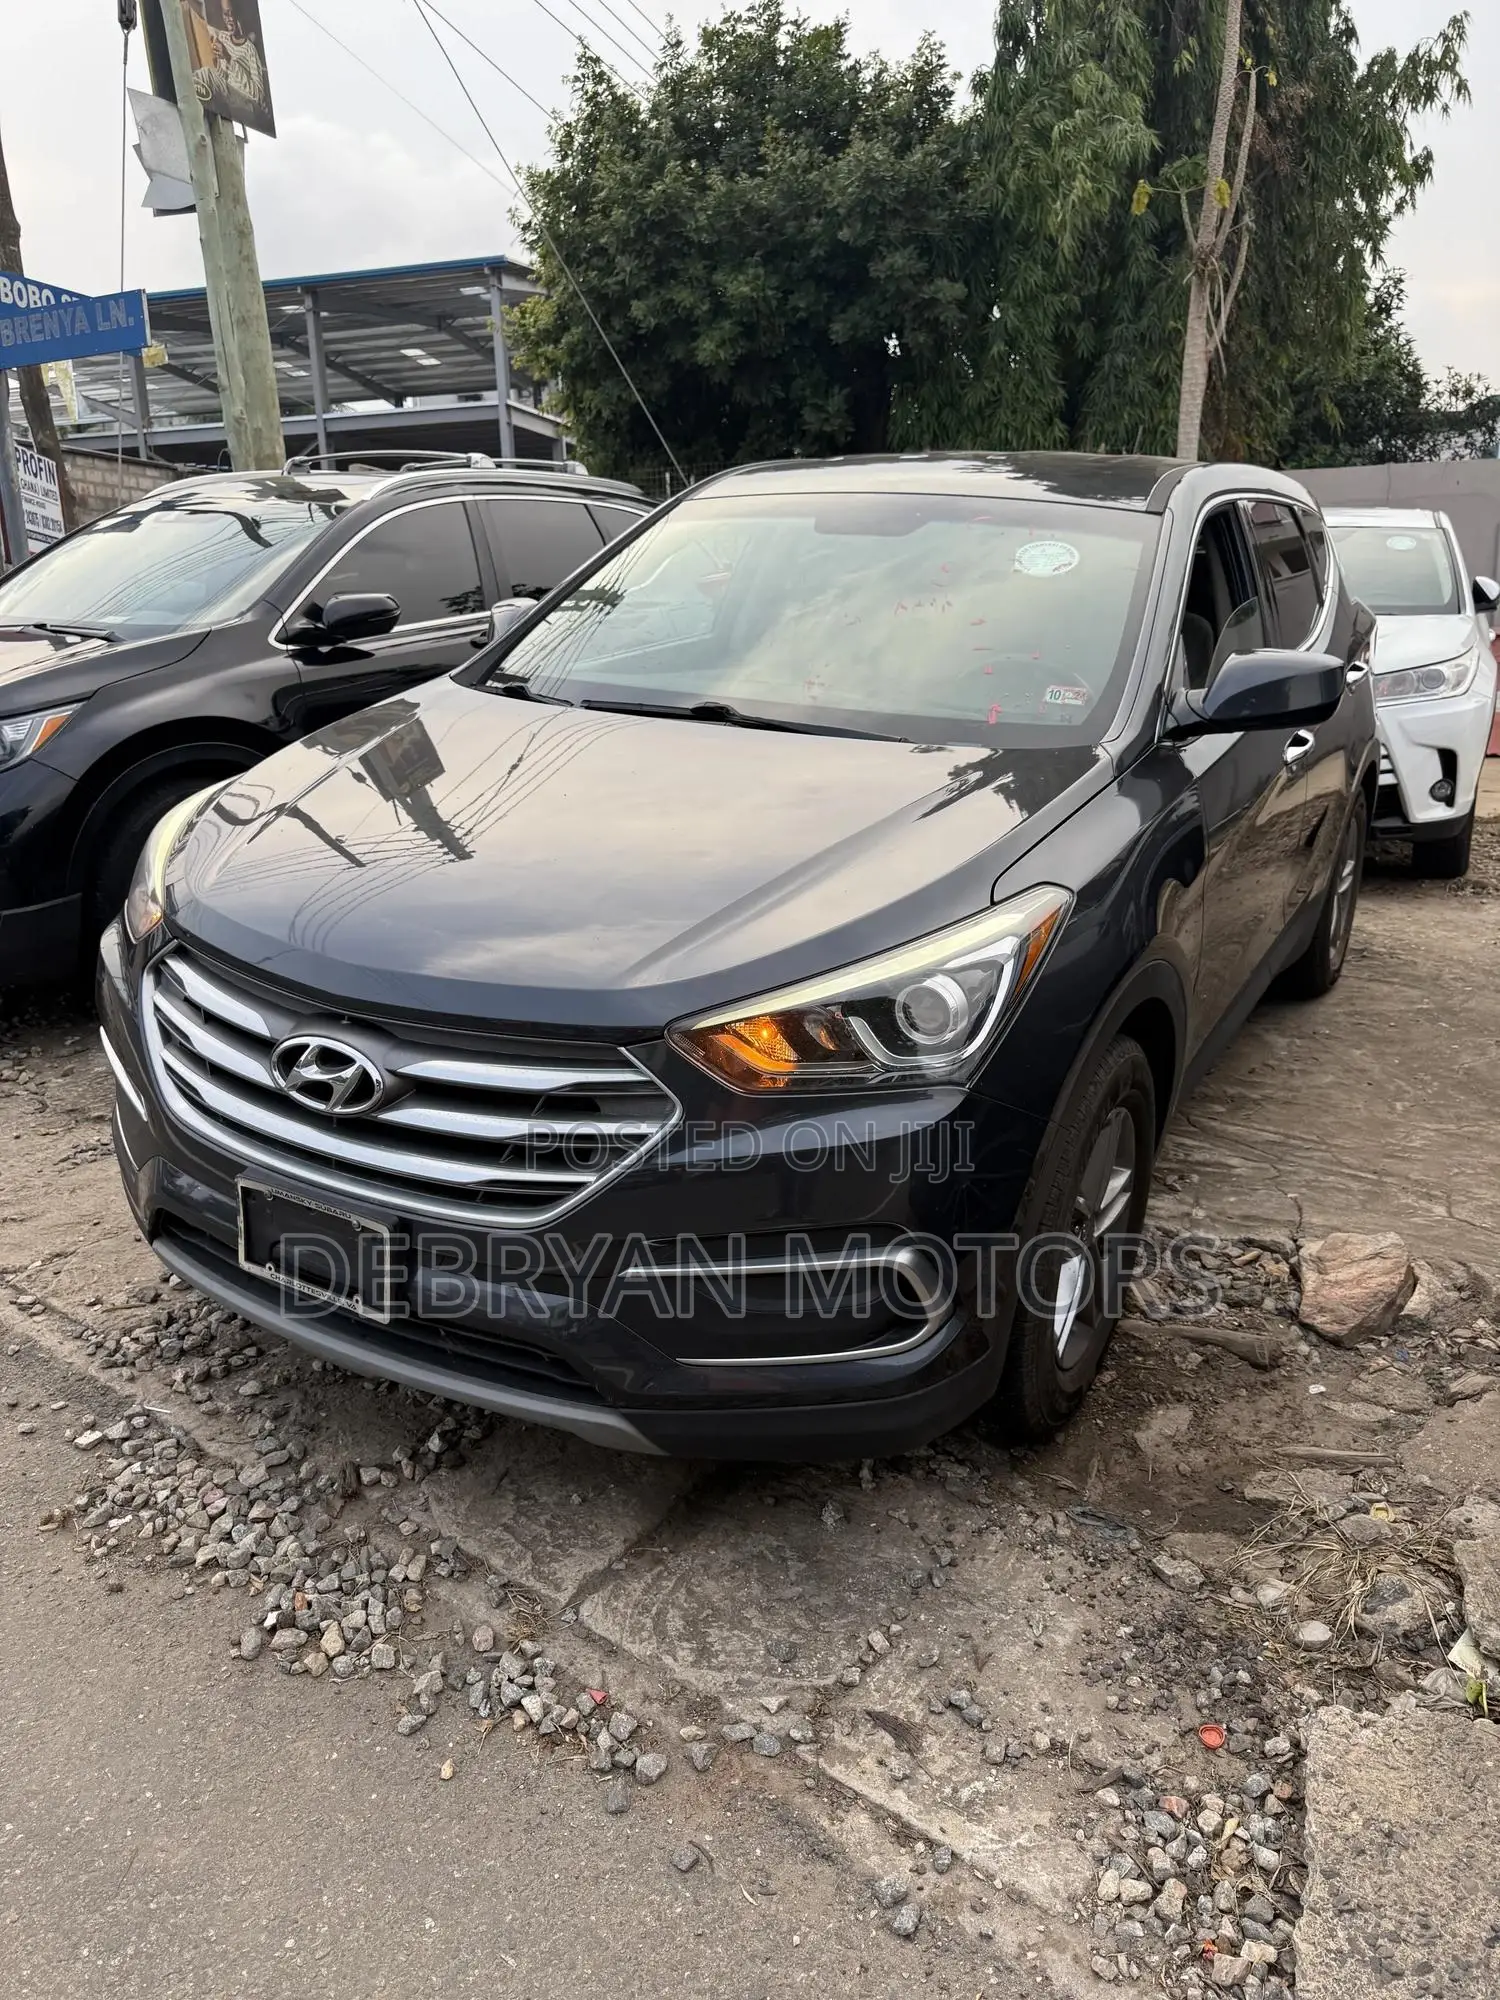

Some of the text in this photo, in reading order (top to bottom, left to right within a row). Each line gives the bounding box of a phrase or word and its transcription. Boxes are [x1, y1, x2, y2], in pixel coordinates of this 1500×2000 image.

[0, 299, 134, 347] BRENYA LN.
[14, 446, 56, 486] PROFIN
[1048, 689, 1062, 701] 10
